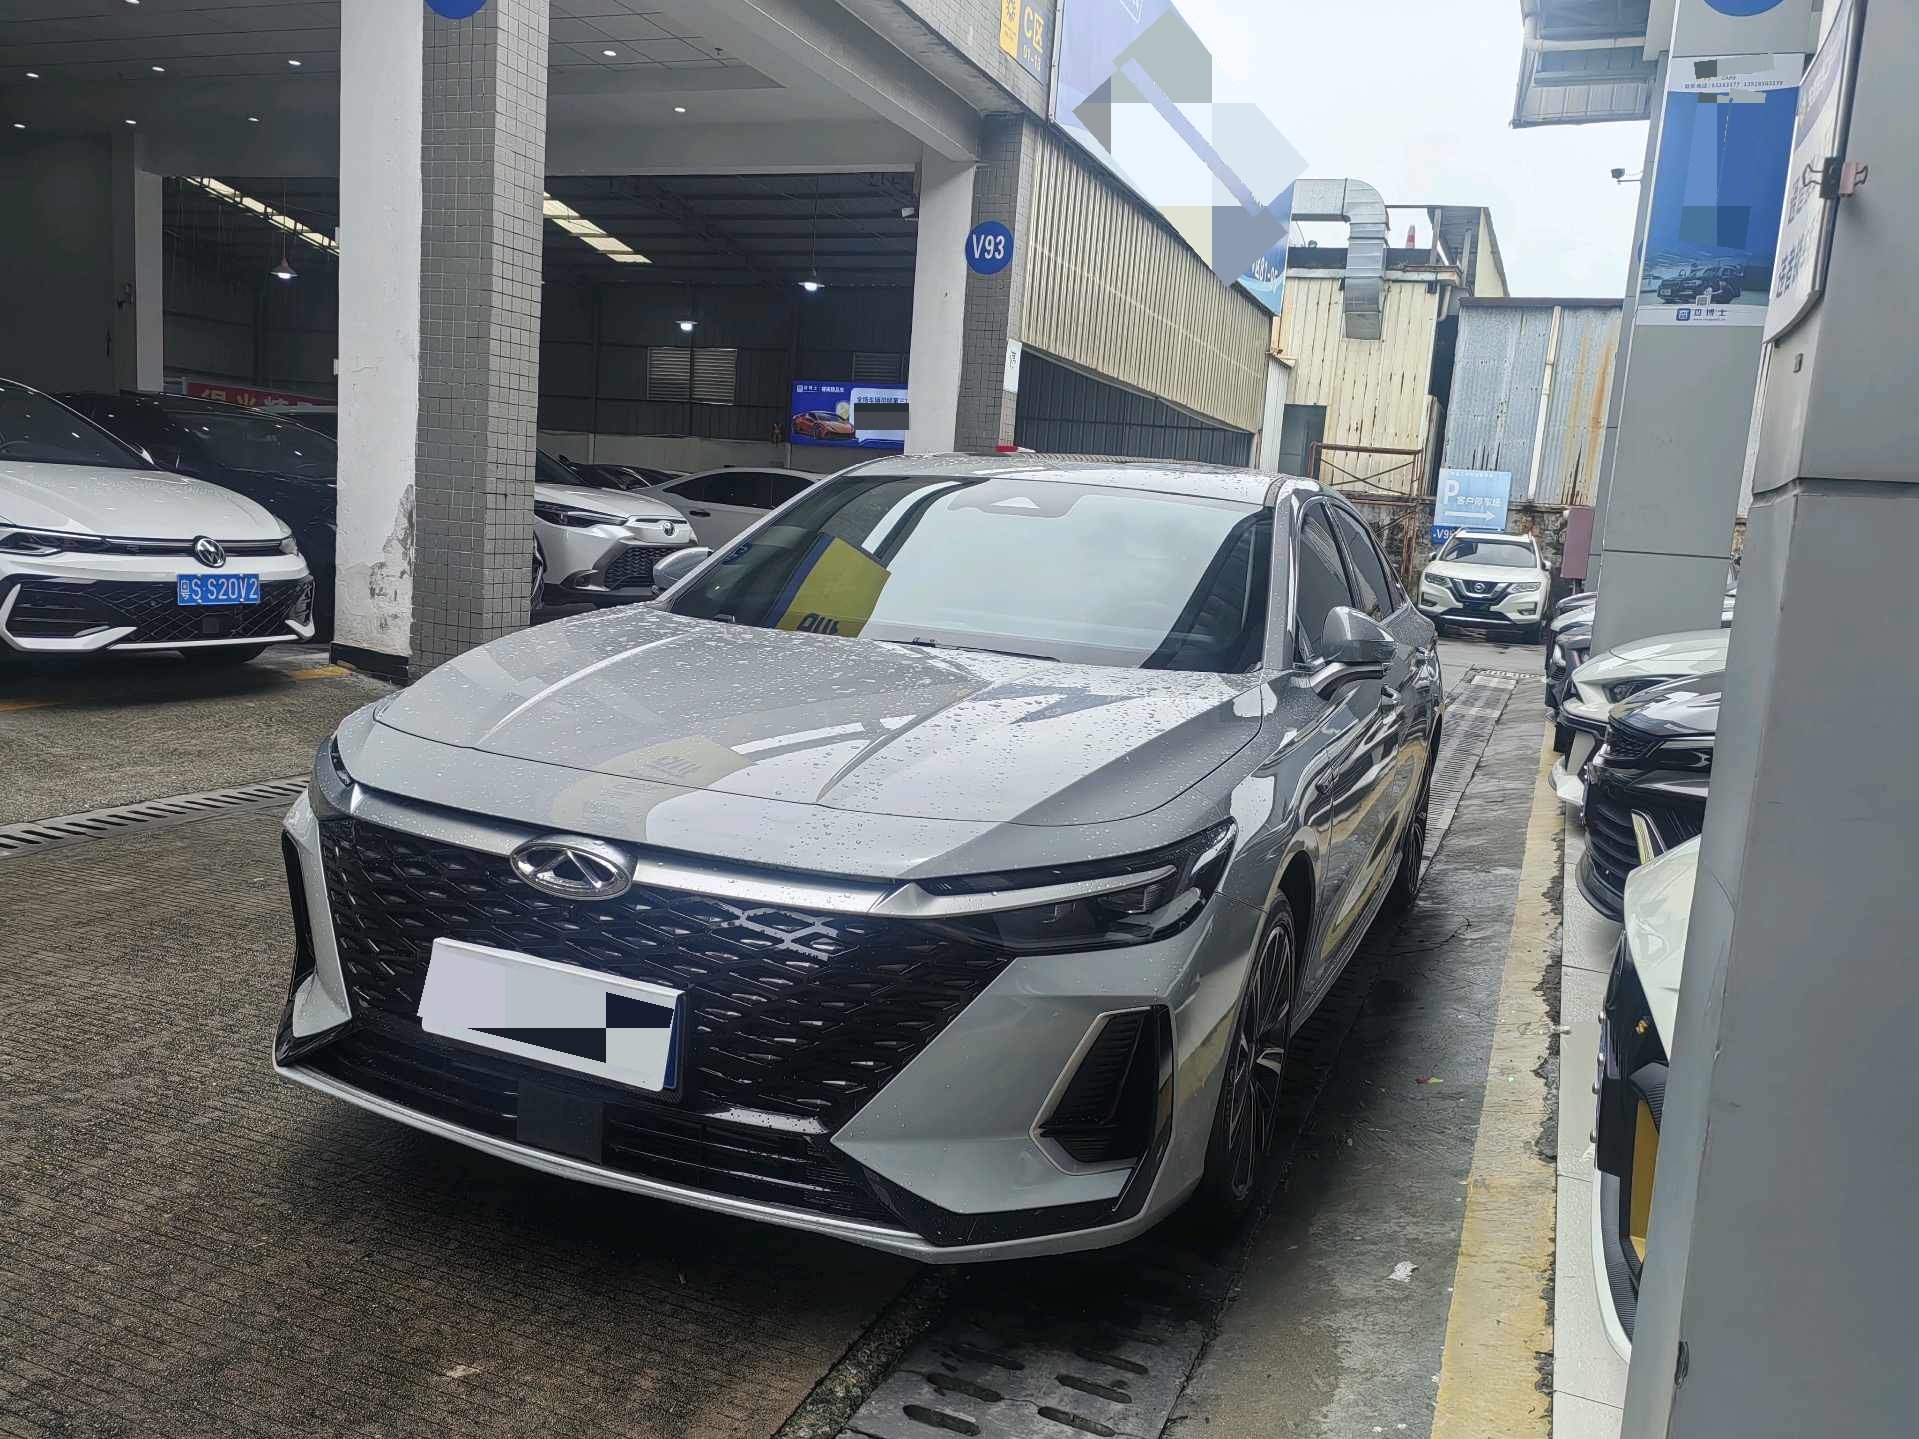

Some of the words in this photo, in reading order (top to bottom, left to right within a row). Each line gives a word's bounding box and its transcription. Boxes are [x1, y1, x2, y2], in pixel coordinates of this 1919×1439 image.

[1024, 6, 1044, 54] C区
[972, 233, 1005, 260] V93
[1443, 479, 1460, 505] P
